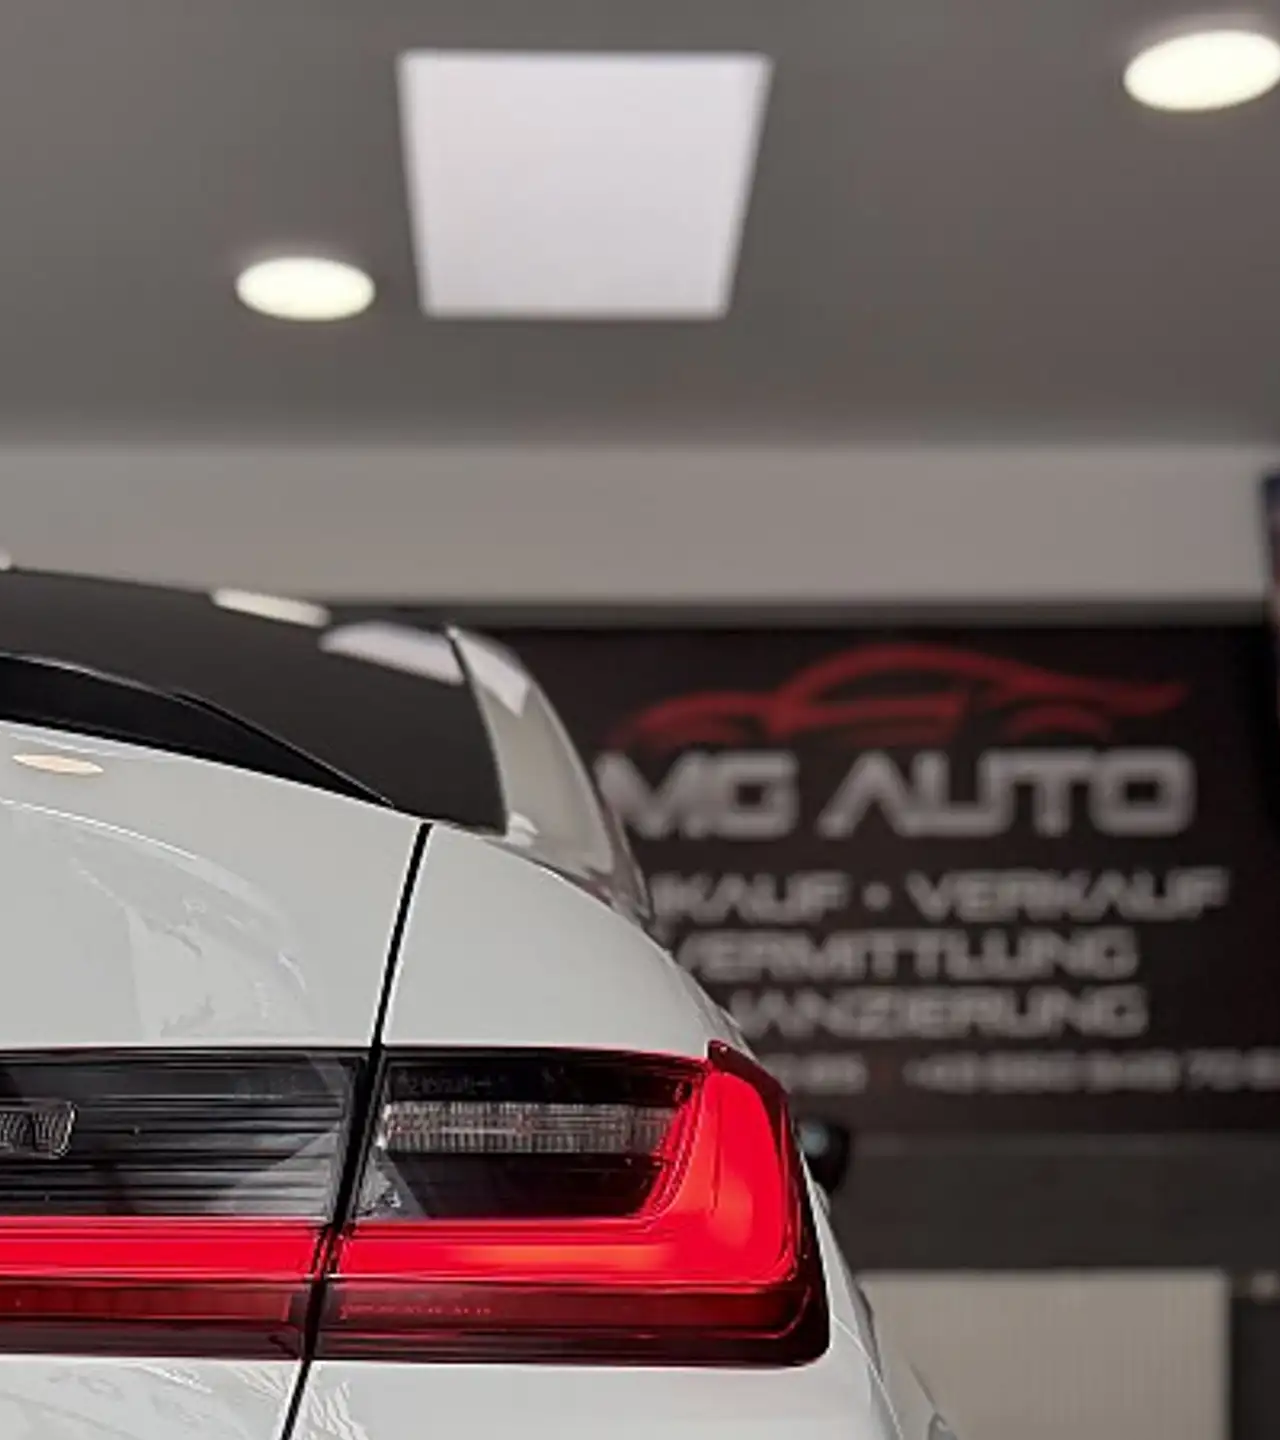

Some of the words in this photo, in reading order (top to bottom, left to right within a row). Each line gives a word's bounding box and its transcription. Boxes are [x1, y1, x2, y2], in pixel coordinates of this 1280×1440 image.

[592, 750, 800, 840] MG
[814, 749, 1197, 839] AUTO
[904, 868, 1231, 922] VERKAUF
